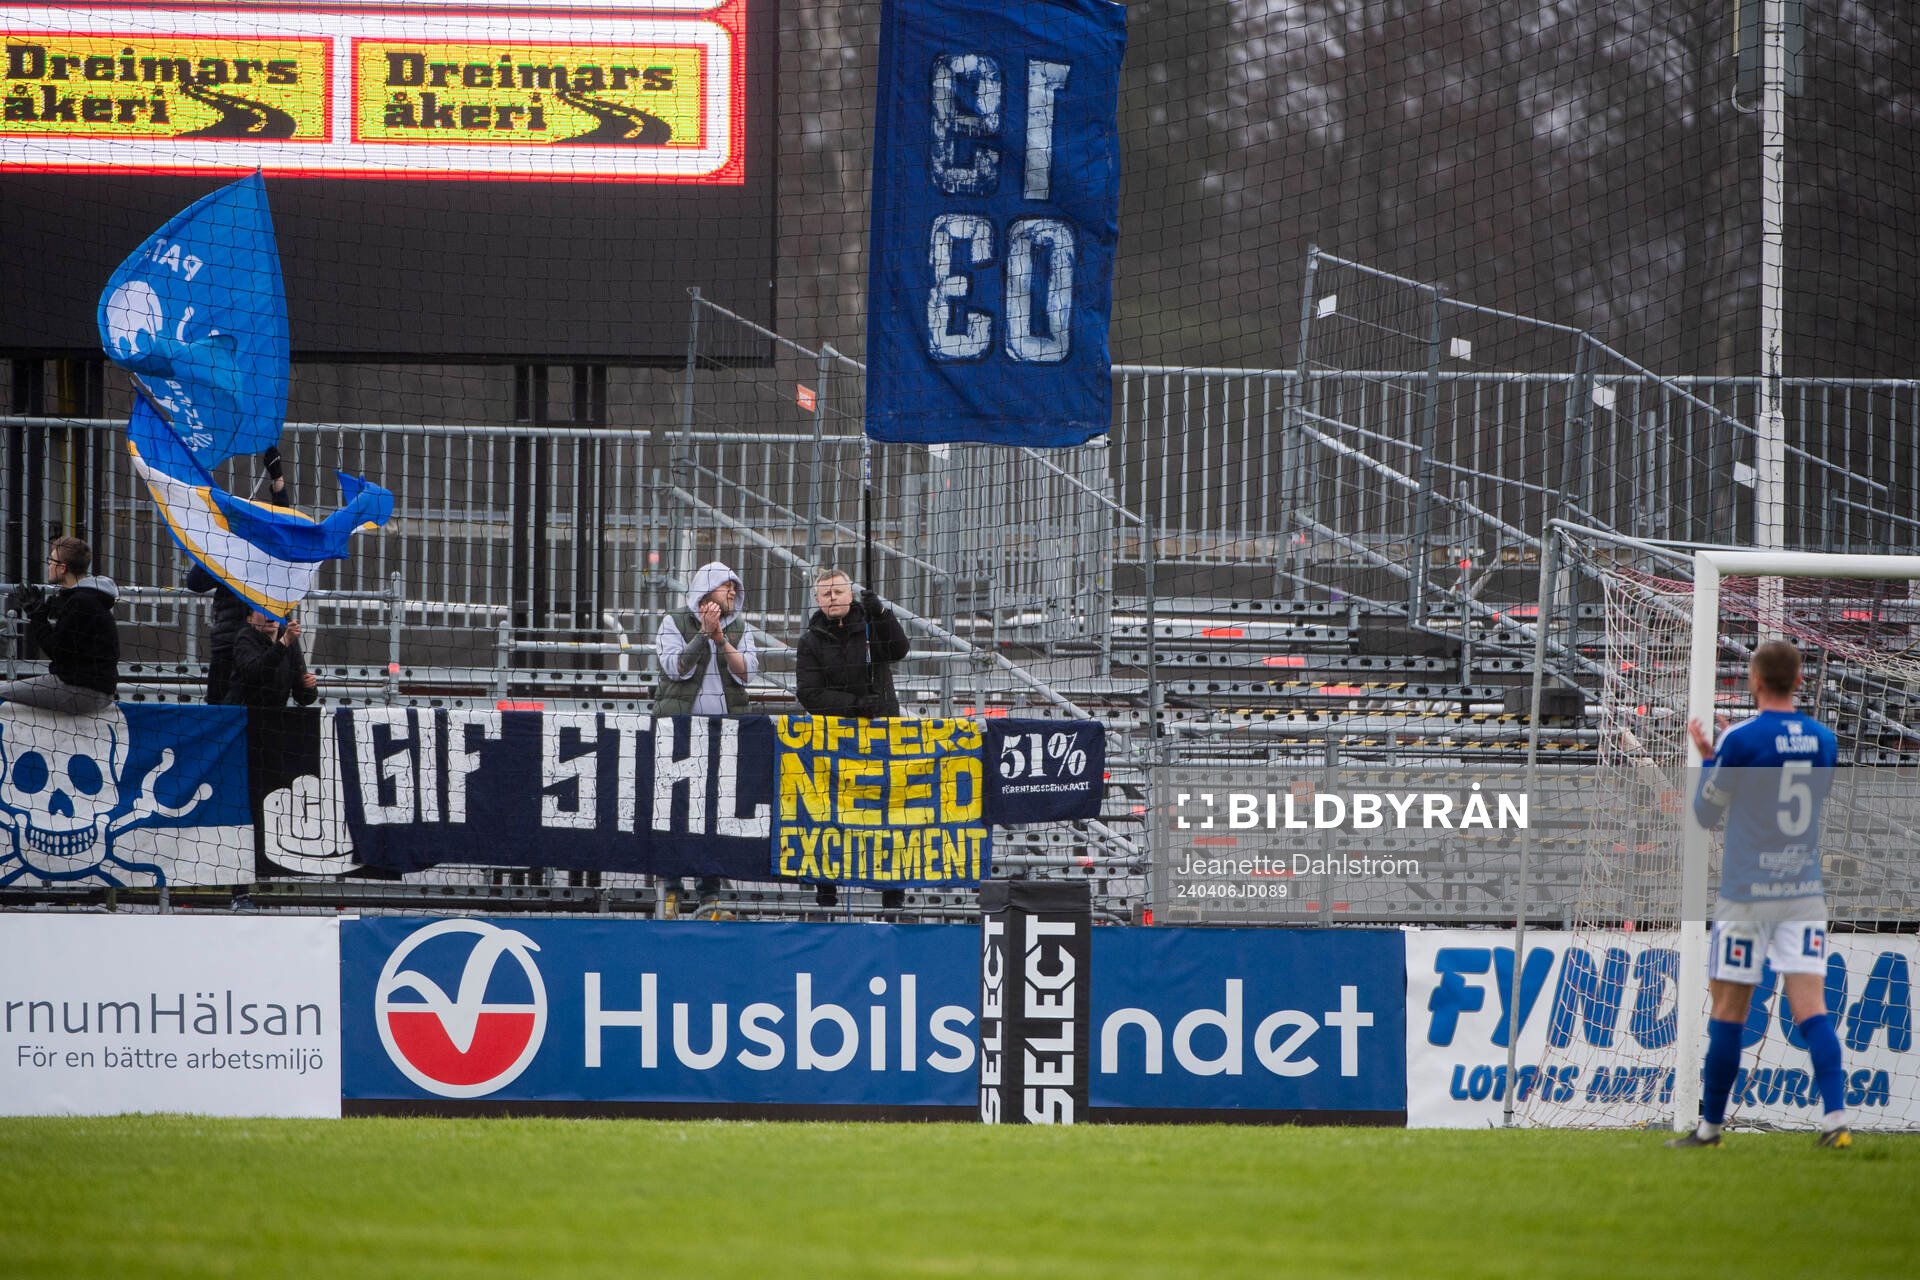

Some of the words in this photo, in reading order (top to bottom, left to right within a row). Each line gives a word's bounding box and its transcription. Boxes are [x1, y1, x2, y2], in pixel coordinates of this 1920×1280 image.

[6, 45, 298, 85] Dreimars
[386, 51, 673, 92] Dreimars
[5, 84, 170, 123] åkeri
[384, 91, 547, 130] åkeri
[777, 714, 983, 755] GIFFERS
[1000, 731, 1087, 779] 51%
[353, 708, 502, 824] GIF
[541, 711, 772, 838] STHL
[779, 753, 984, 825] NEED
[1777, 760, 1812, 836] 5
[780, 826, 988, 881] EXCITEMENT
[6, 990, 322, 1036] rnumHälsan
[584, 972, 1374, 1077] Husbilsndet
[981, 914, 1004, 1124] SELECT
[1024, 914, 1076, 1124] SELECT
[17, 1045, 58, 1068] För
[65, 1051, 95, 1068] en
[104, 1046, 178, 1069] bättre
[187, 1047, 324, 1075] arbetsmiljö
[1585, 1065, 1676, 1104] ANTI
[1731, 1067, 1890, 1108] KURISA
